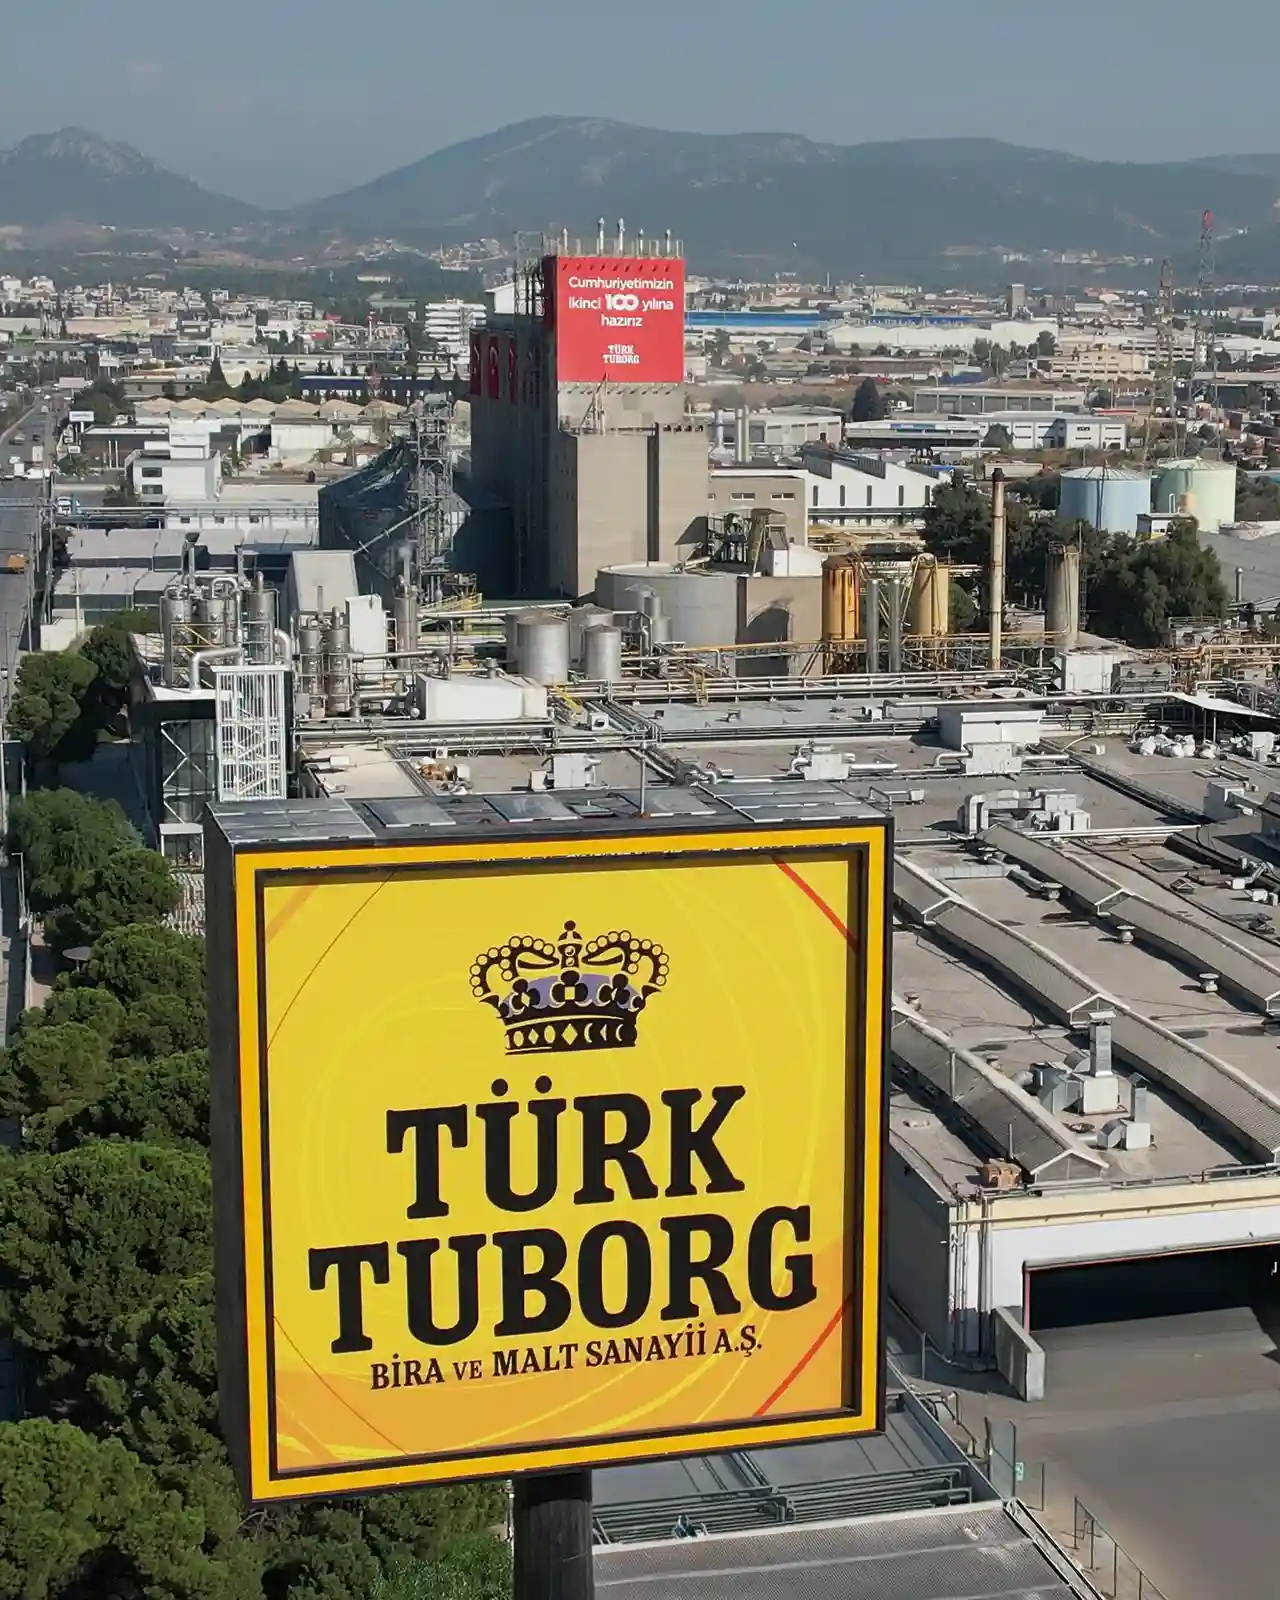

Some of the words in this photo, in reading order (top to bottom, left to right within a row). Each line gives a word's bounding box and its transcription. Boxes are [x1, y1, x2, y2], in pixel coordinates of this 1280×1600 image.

[568, 276, 674, 291] Cumhuriyetimizin
[604, 294, 640, 311] 100
[642, 298, 674, 312] yılına
[601, 314, 643, 327] hazırız
[607, 344, 634, 354] TÜRK
[602, 354, 640, 364] TUBORG
[387, 1076, 745, 1220] TÜRK
[308, 1206, 817, 1354] TUBORG
[370, 1352, 445, 1390] BİRA
[452, 1359, 482, 1381] VE
[492, 1343, 579, 1377] MALT
[586, 1322, 707, 1368] SANAYİİ
[712, 1325, 763, 1358] A.Ş.
